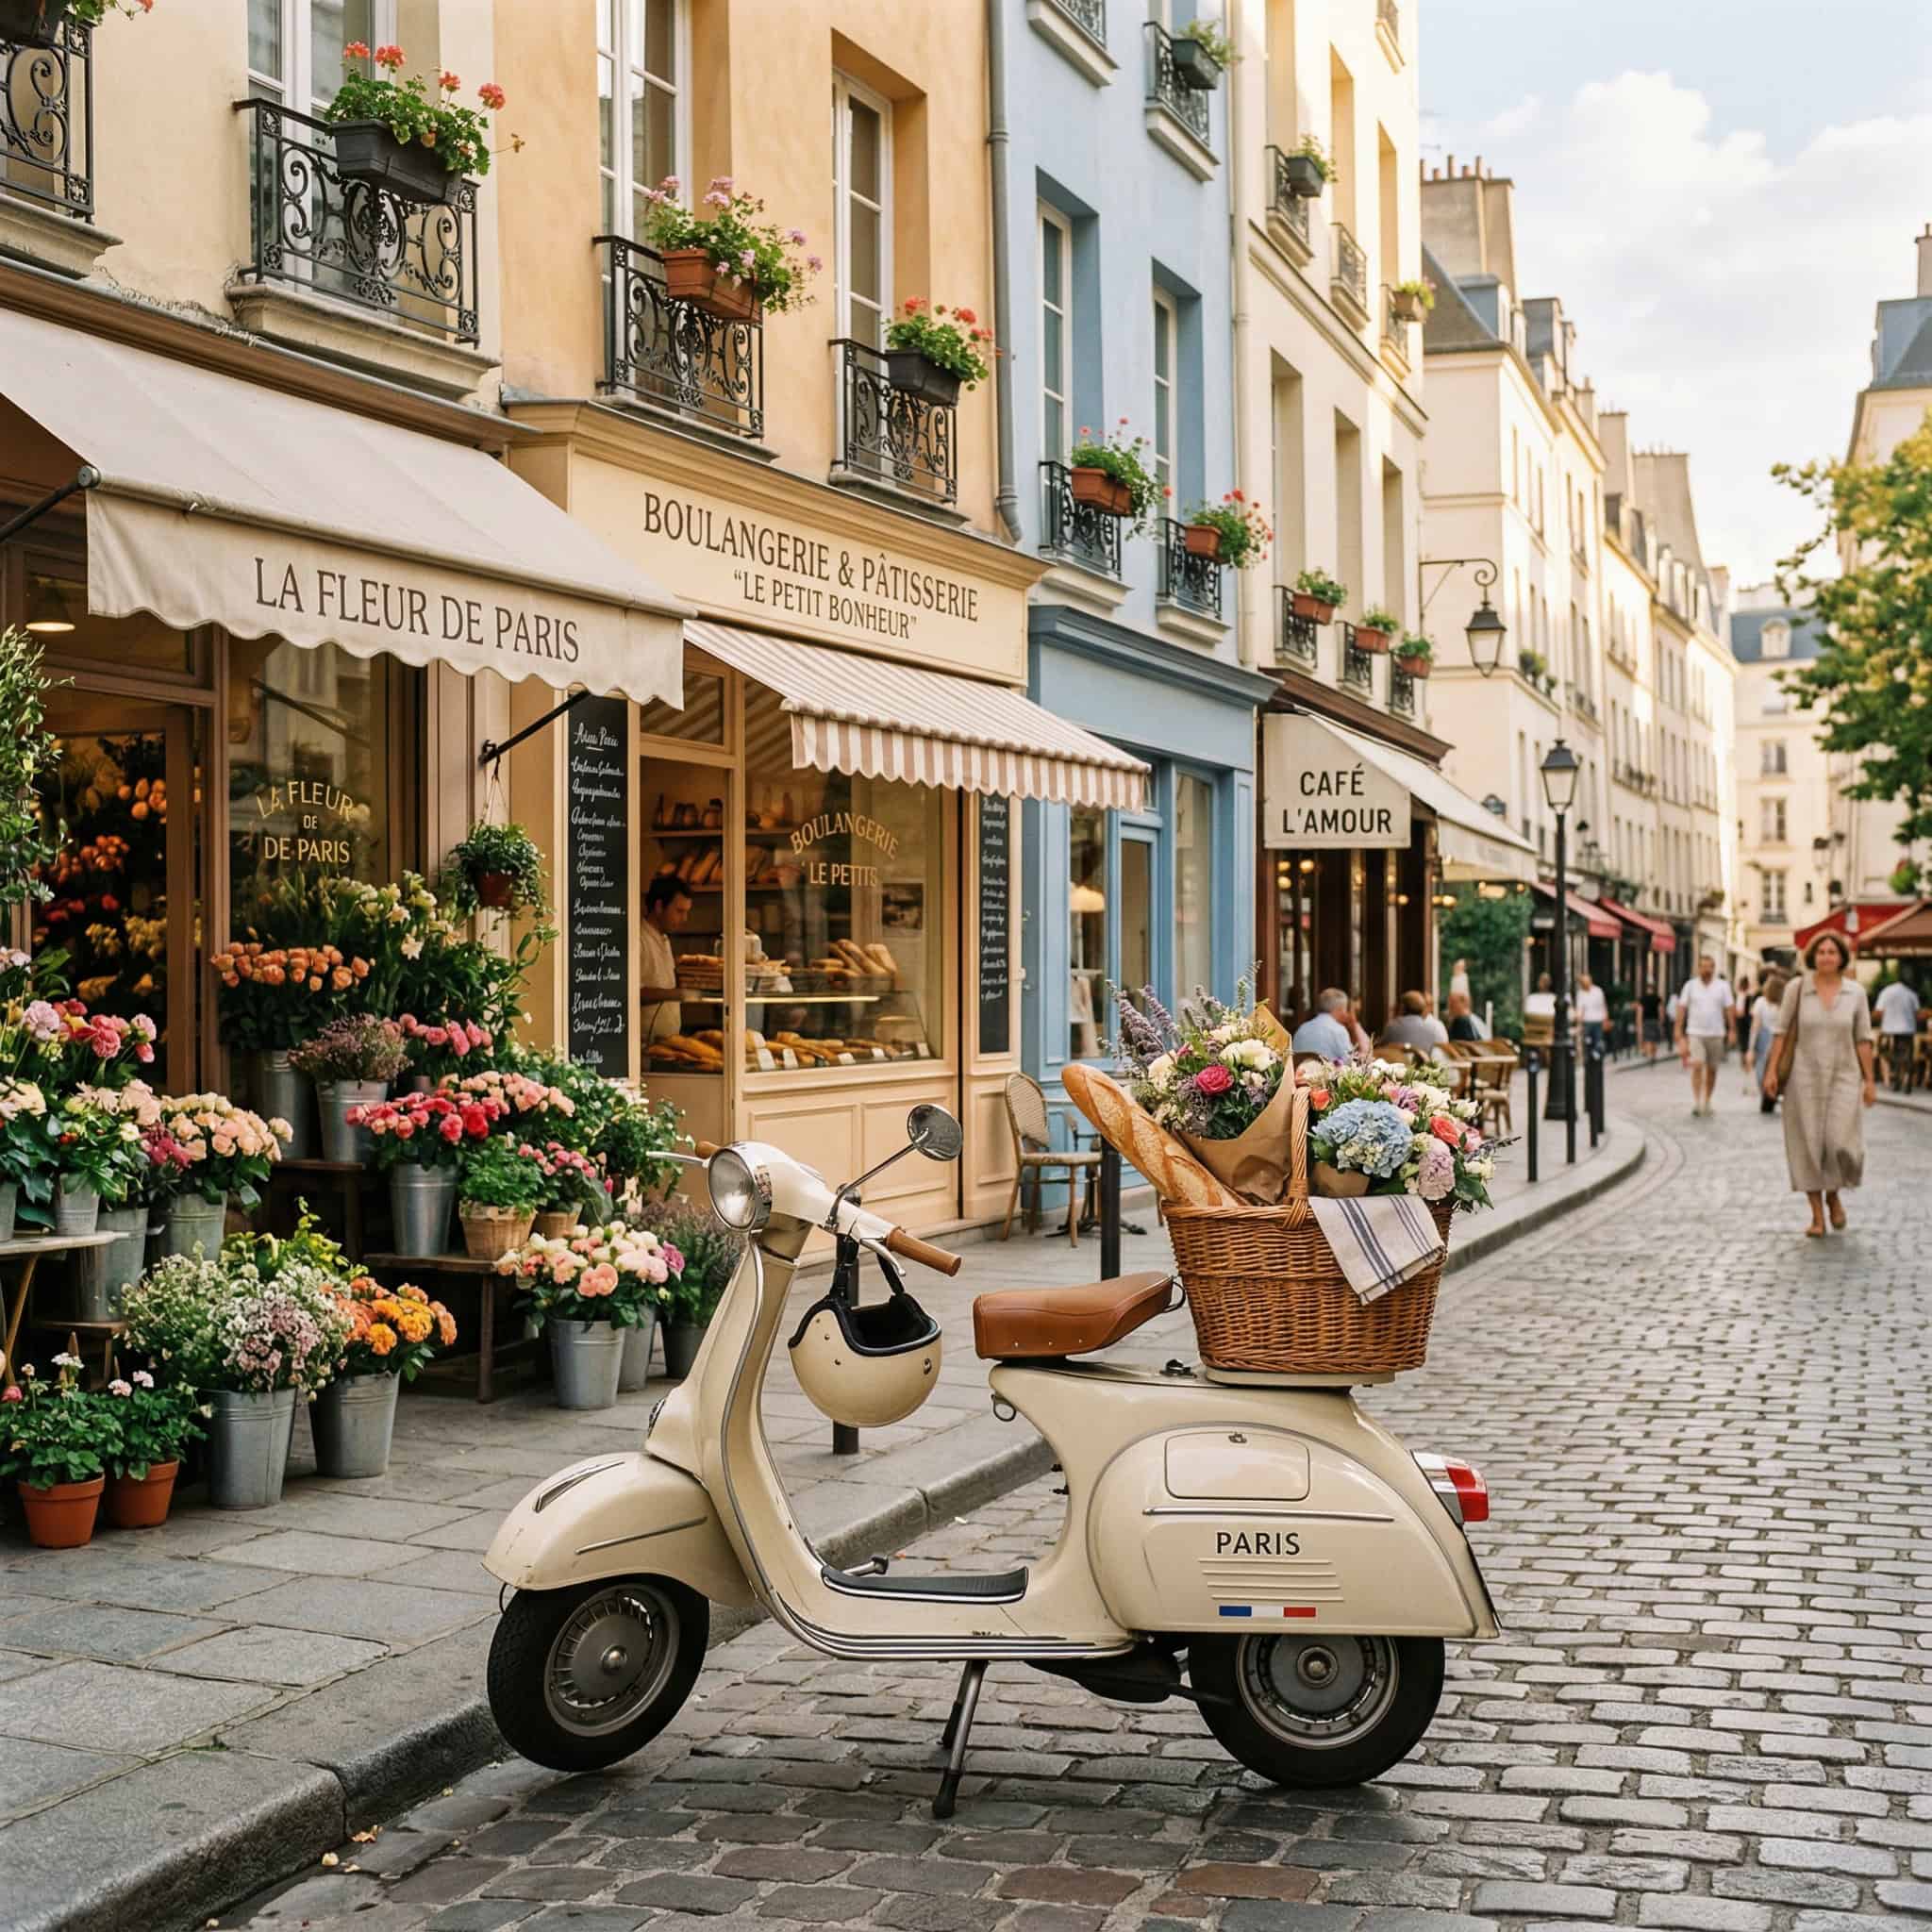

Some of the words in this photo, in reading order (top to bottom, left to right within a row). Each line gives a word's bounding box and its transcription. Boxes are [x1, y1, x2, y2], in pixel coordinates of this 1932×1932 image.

[643, 491, 830, 581] BOULANGERIE
[838, 550, 855, 589] &
[861, 553, 978, 623] PÂTISSERIE
[255, 558, 304, 613] LA
[316, 569, 430, 636] FLEUR
[441, 595, 484, 646] DE
[495, 607, 579, 662] PARIS
[772, 579, 824, 618] PETIT
[1300, 762, 1365, 796] CAFÉ
[287, 780, 354, 822] FLEUR
[303, 814, 318, 829] DE
[791, 812, 899, 860] BOULANGERIE
[1282, 808, 1392, 834] L'AMOUR
[264, 836, 291, 860] DE
[297, 838, 350, 863] PARIS
[1216, 1531, 1301, 1556] PARIS
